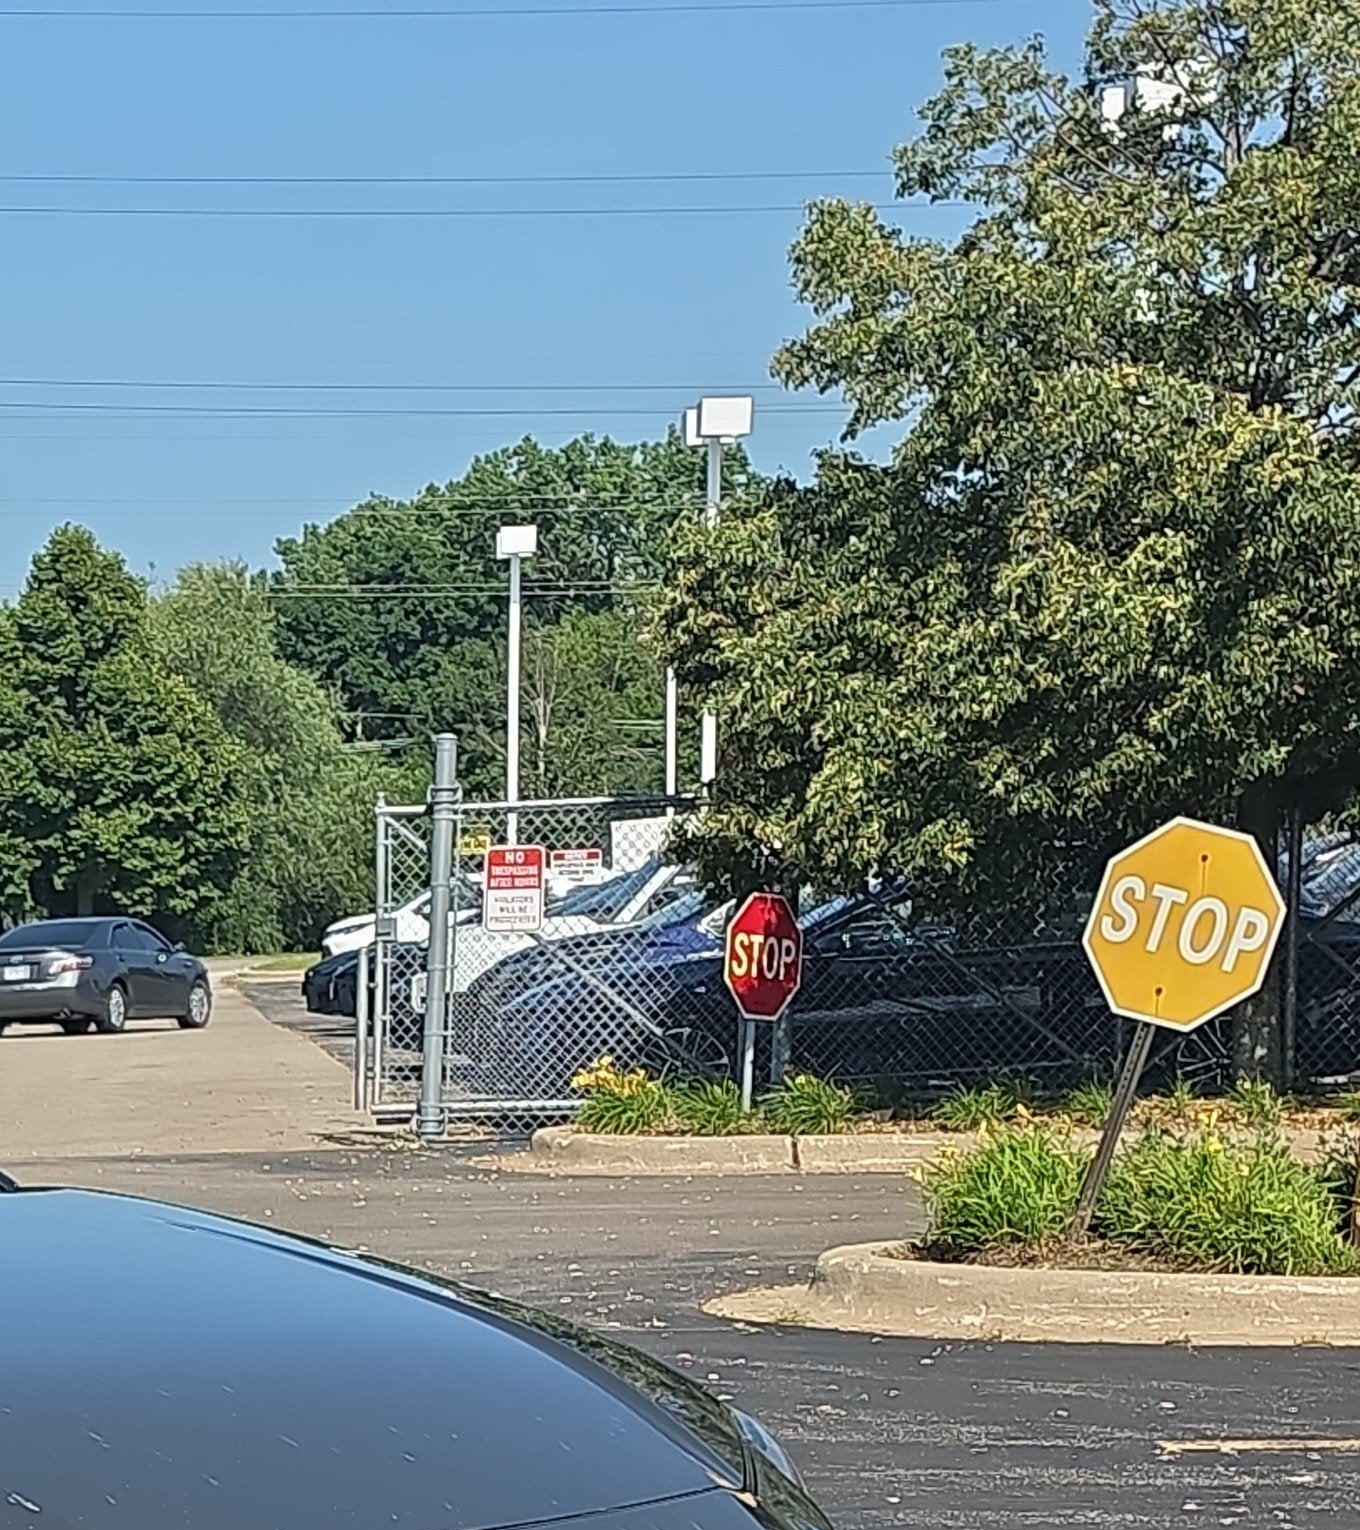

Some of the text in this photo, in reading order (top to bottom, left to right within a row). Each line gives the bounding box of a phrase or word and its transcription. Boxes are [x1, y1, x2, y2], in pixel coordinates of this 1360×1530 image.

[505, 851, 525, 865] NO
[1100, 875, 1269, 973] STOP
[731, 932, 797, 981] STOP
